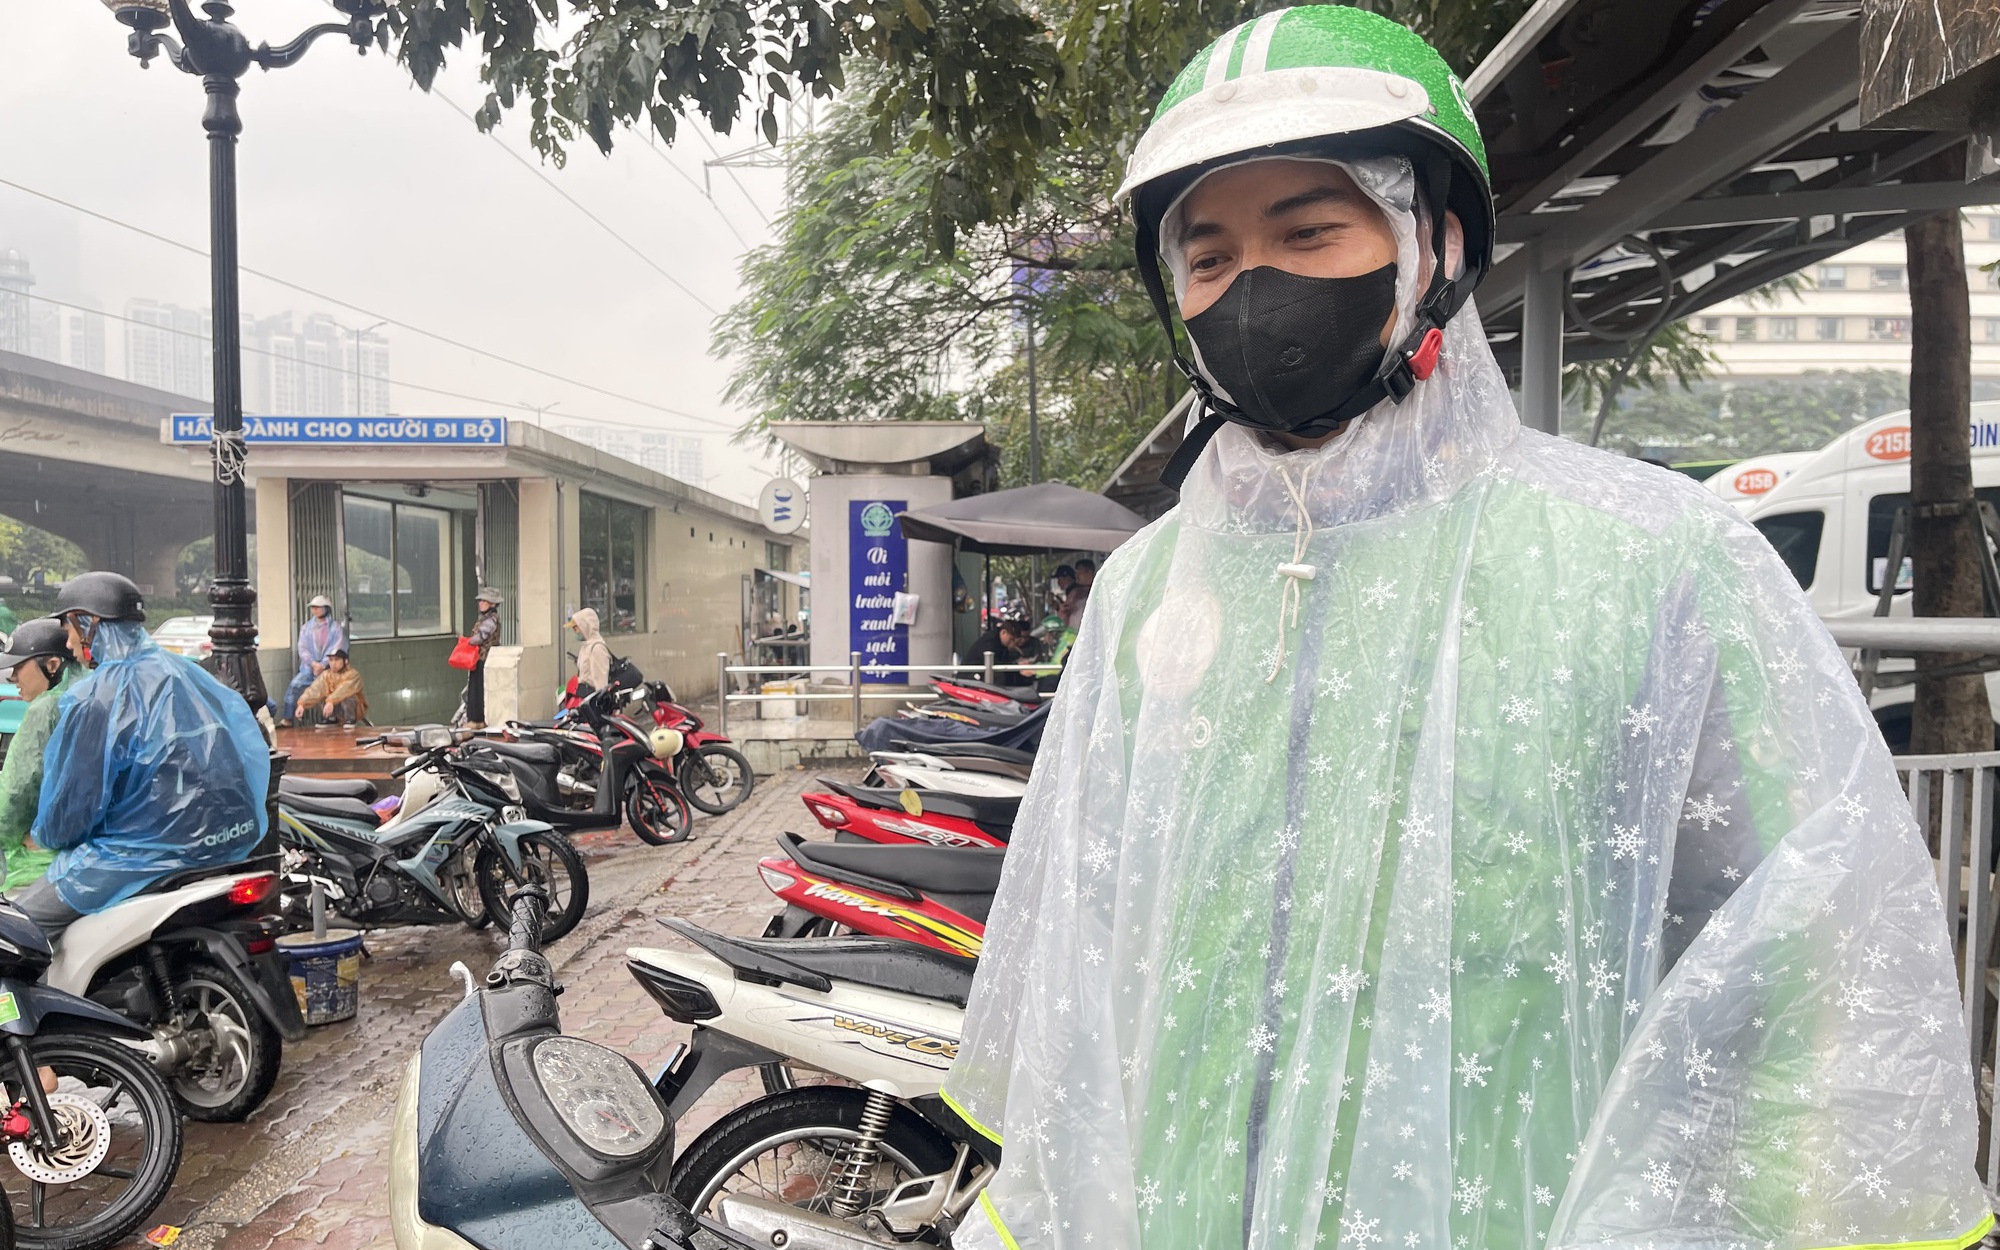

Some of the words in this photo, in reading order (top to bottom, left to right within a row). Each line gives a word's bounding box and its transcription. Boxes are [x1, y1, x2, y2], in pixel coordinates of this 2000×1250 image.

[304, 421, 353, 437] CHO
[358, 418, 428, 438] NGƯỜI
[433, 422, 457, 438] ĐI
[463, 419, 495, 442] BỘ
[773, 488, 793, 523] WC
[864, 571, 891, 587] môi
[865, 636, 896, 656] sạch
[204, 819, 255, 847] adidas
[834, 1014, 915, 1043] WAVE
